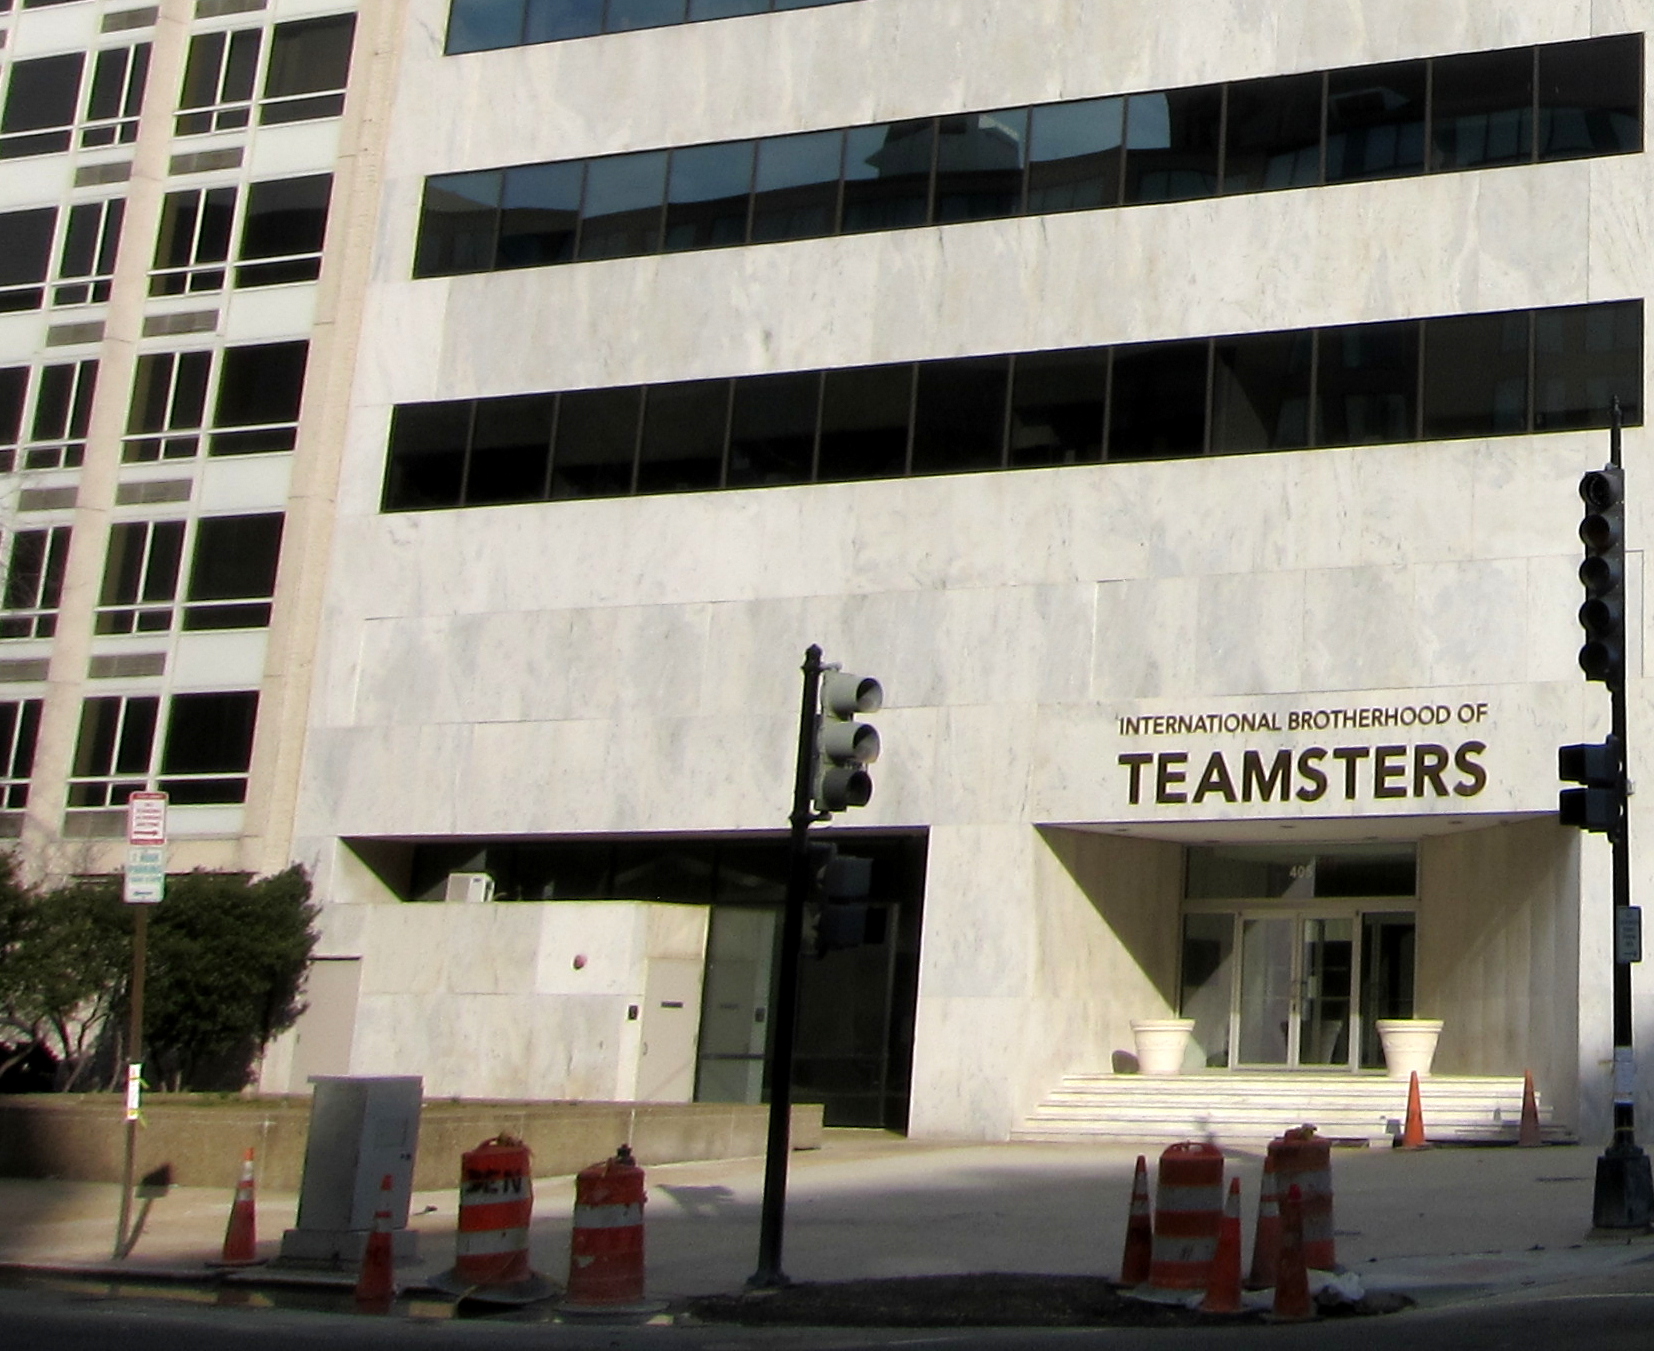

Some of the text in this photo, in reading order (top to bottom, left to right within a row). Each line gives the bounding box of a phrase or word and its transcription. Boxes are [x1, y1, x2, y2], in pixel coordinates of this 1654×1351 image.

[1119, 703, 1488, 735] INTERNATIONAL BROTHERHOOD OF
[1118, 740, 1487, 805] TEAMSTERS
